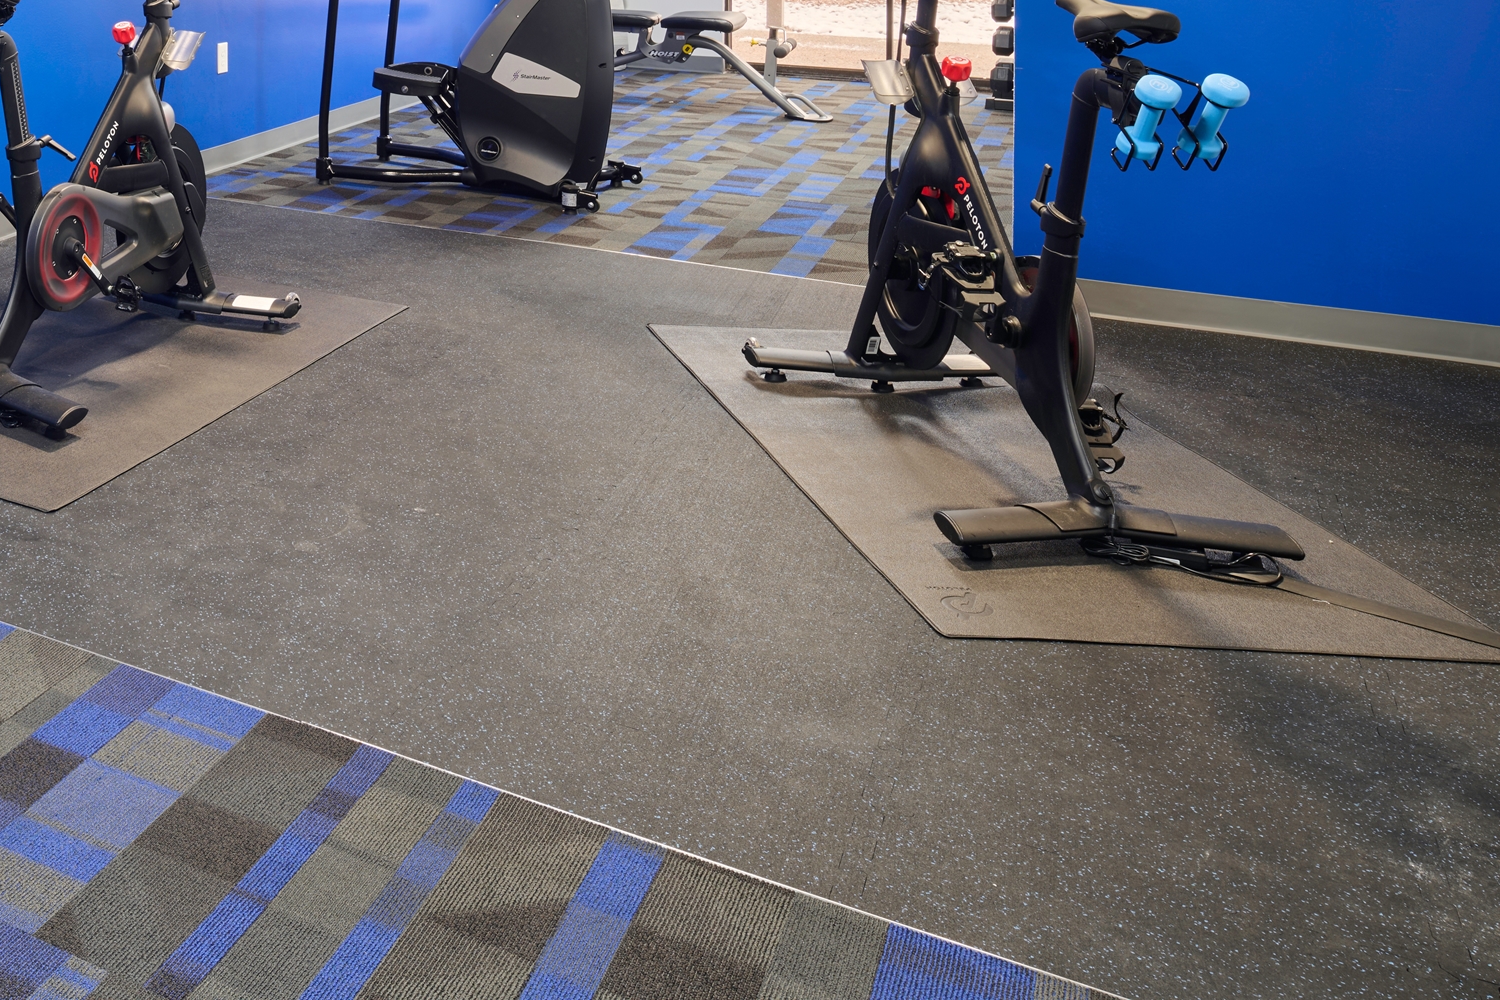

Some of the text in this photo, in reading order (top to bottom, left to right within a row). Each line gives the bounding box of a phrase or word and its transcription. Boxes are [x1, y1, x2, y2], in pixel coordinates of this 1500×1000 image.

[520, 73, 551, 81] StairMaster
[96, 121, 119, 165] PELOTON
[963, 194, 988, 249] PELOTON
